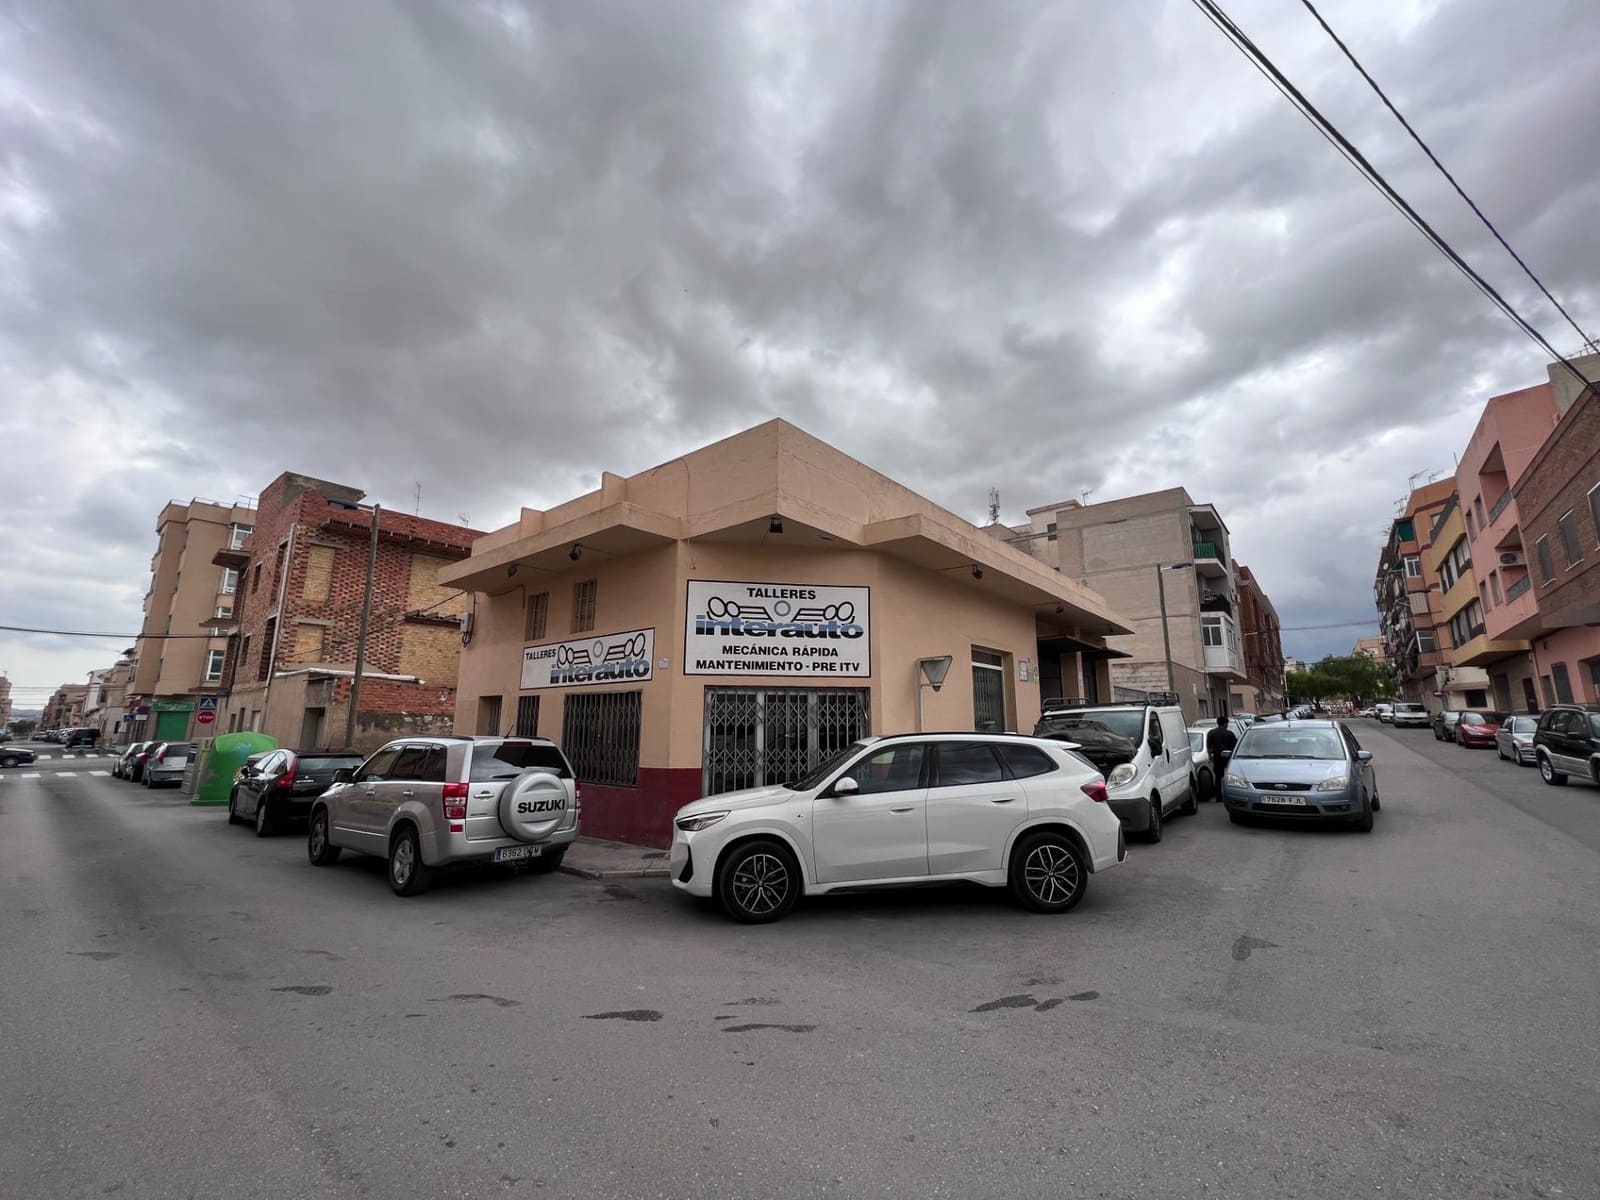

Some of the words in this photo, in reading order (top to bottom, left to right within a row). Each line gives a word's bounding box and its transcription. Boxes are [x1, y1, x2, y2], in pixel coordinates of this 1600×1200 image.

[747, 588, 816, 599] TALLERES
[696, 614, 864, 639] interauto
[525, 649, 556, 660] TALLERES
[722, 644, 788, 656] MECÁNICA
[792, 645, 838, 656] RÁPIDA
[550, 657, 650, 684] interauto
[696, 660, 803, 671] MANTENIMIENTO
[812, 662, 837, 671] PRE
[840, 662, 860, 671] ITV
[517, 800, 565, 813] SUZUKI
